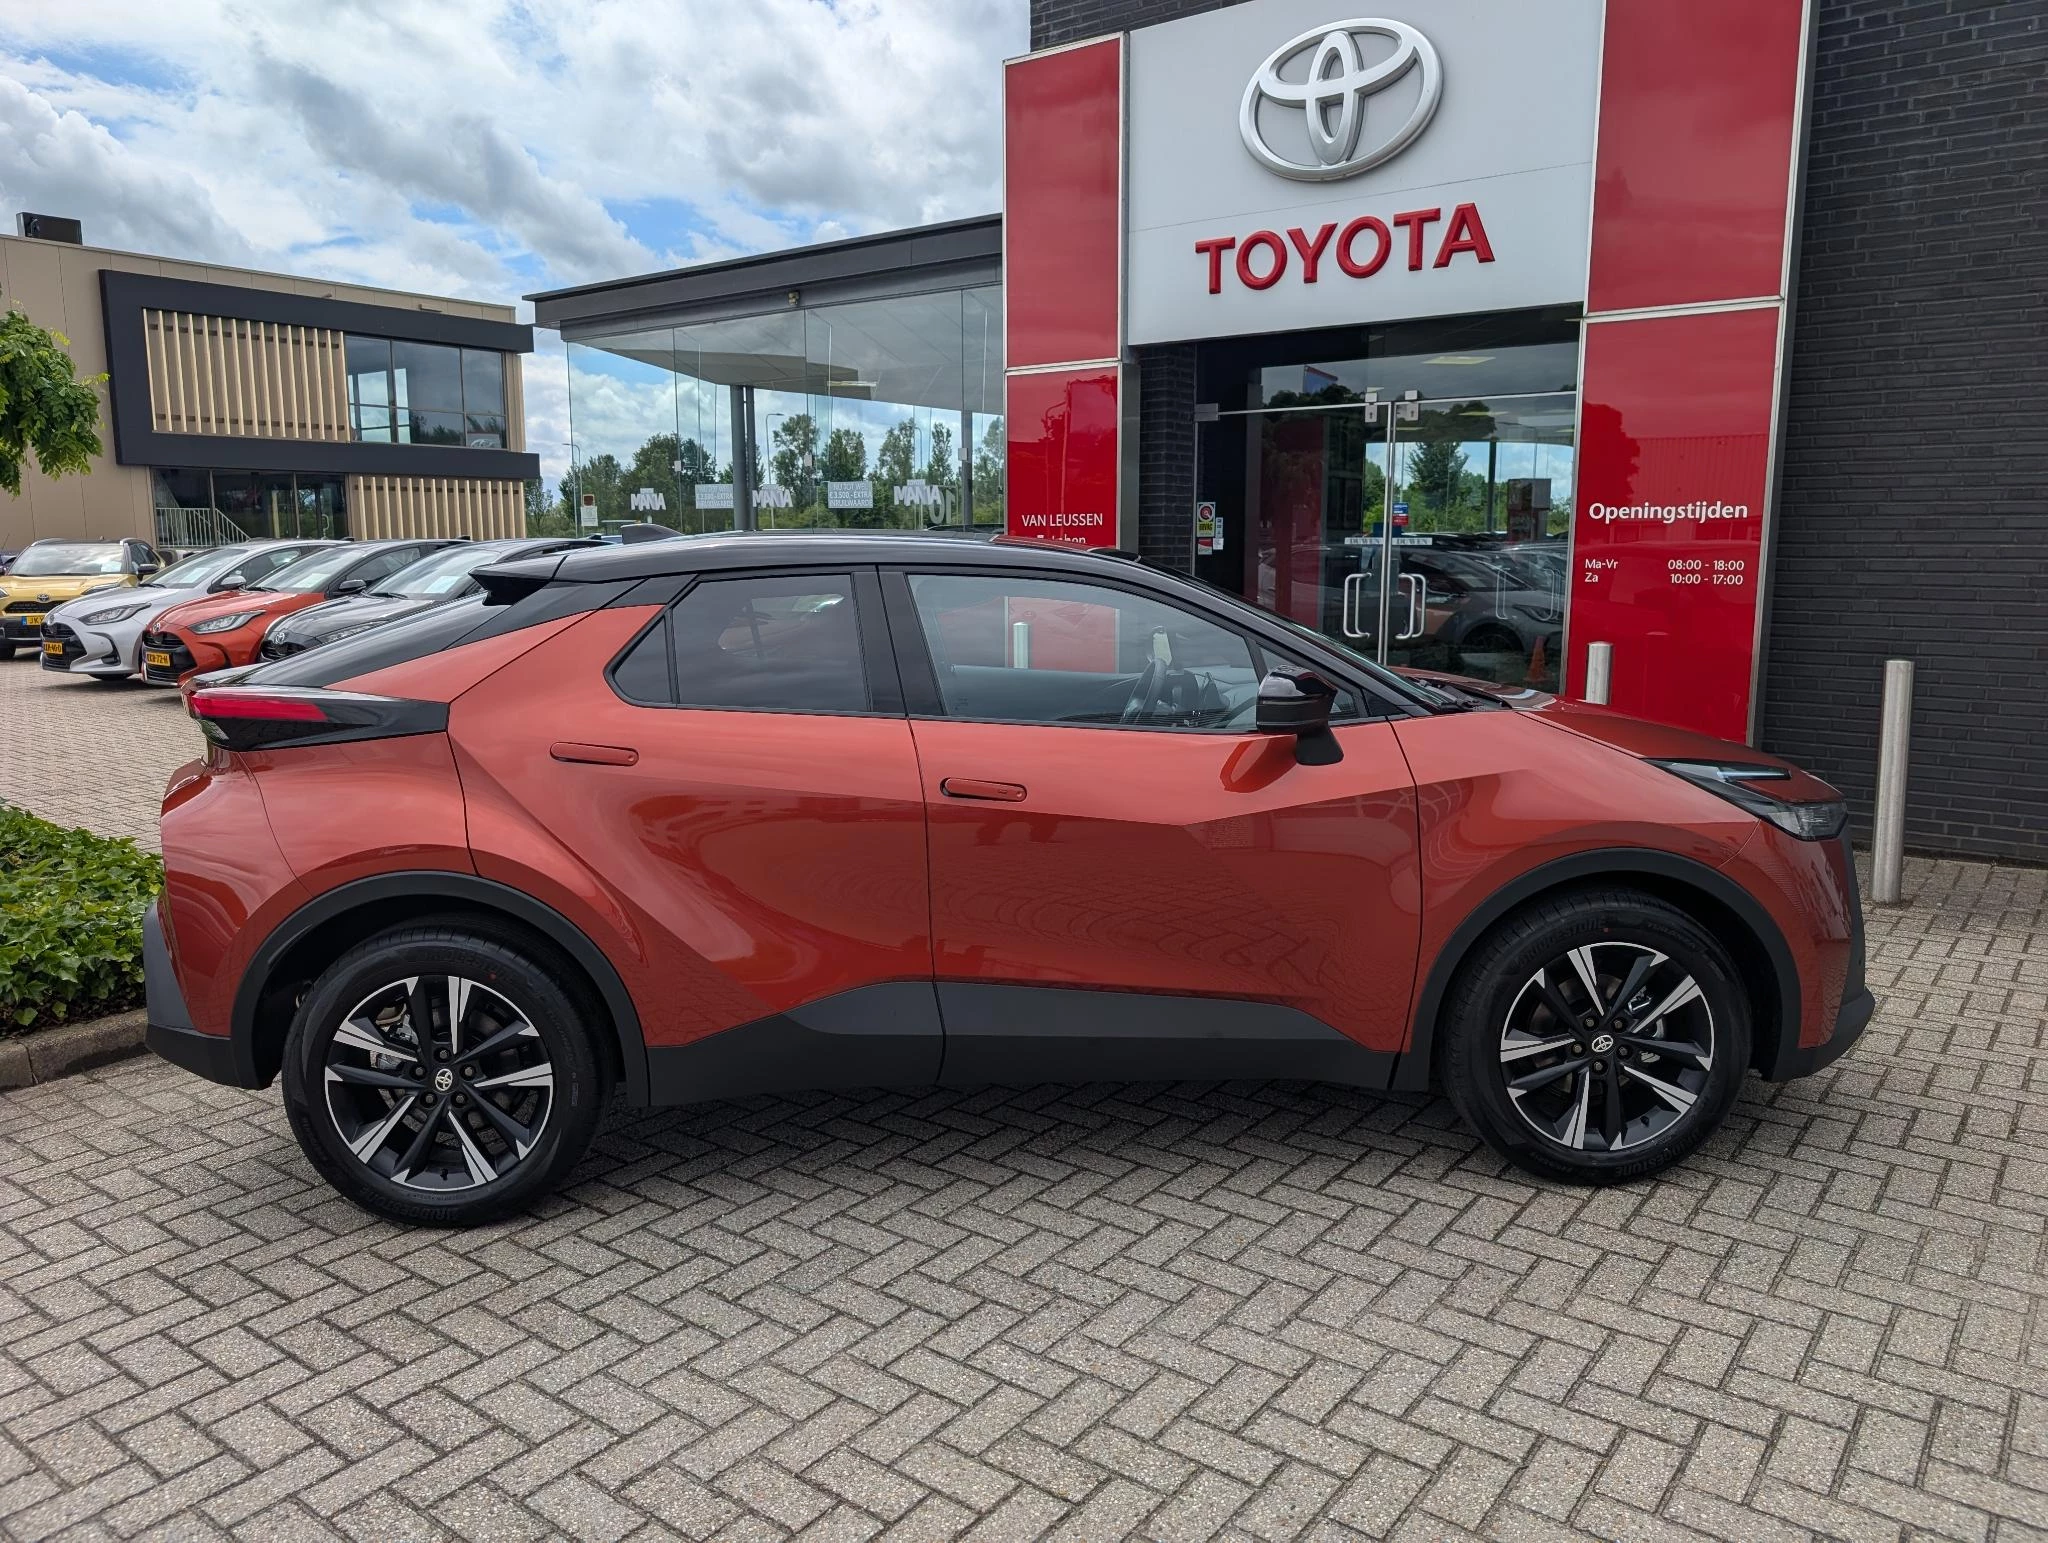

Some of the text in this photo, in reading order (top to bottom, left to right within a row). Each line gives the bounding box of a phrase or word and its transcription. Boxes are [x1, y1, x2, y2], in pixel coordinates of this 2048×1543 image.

[1195, 202, 1496, 295] TOYOTA
[1588, 500, 1749, 524] Openingstijden
[1021, 513, 1103, 527] VAN LEUSSEN
[1584, 559, 1619, 569] Ma-Vr
[1667, 559, 1701, 570] 08:00
[1713, 560, 1745, 571] 18:00
[1584, 572, 1599, 583] Za
[1670, 573, 1701, 584] 10:00
[1712, 574, 1744, 585] 17:00
